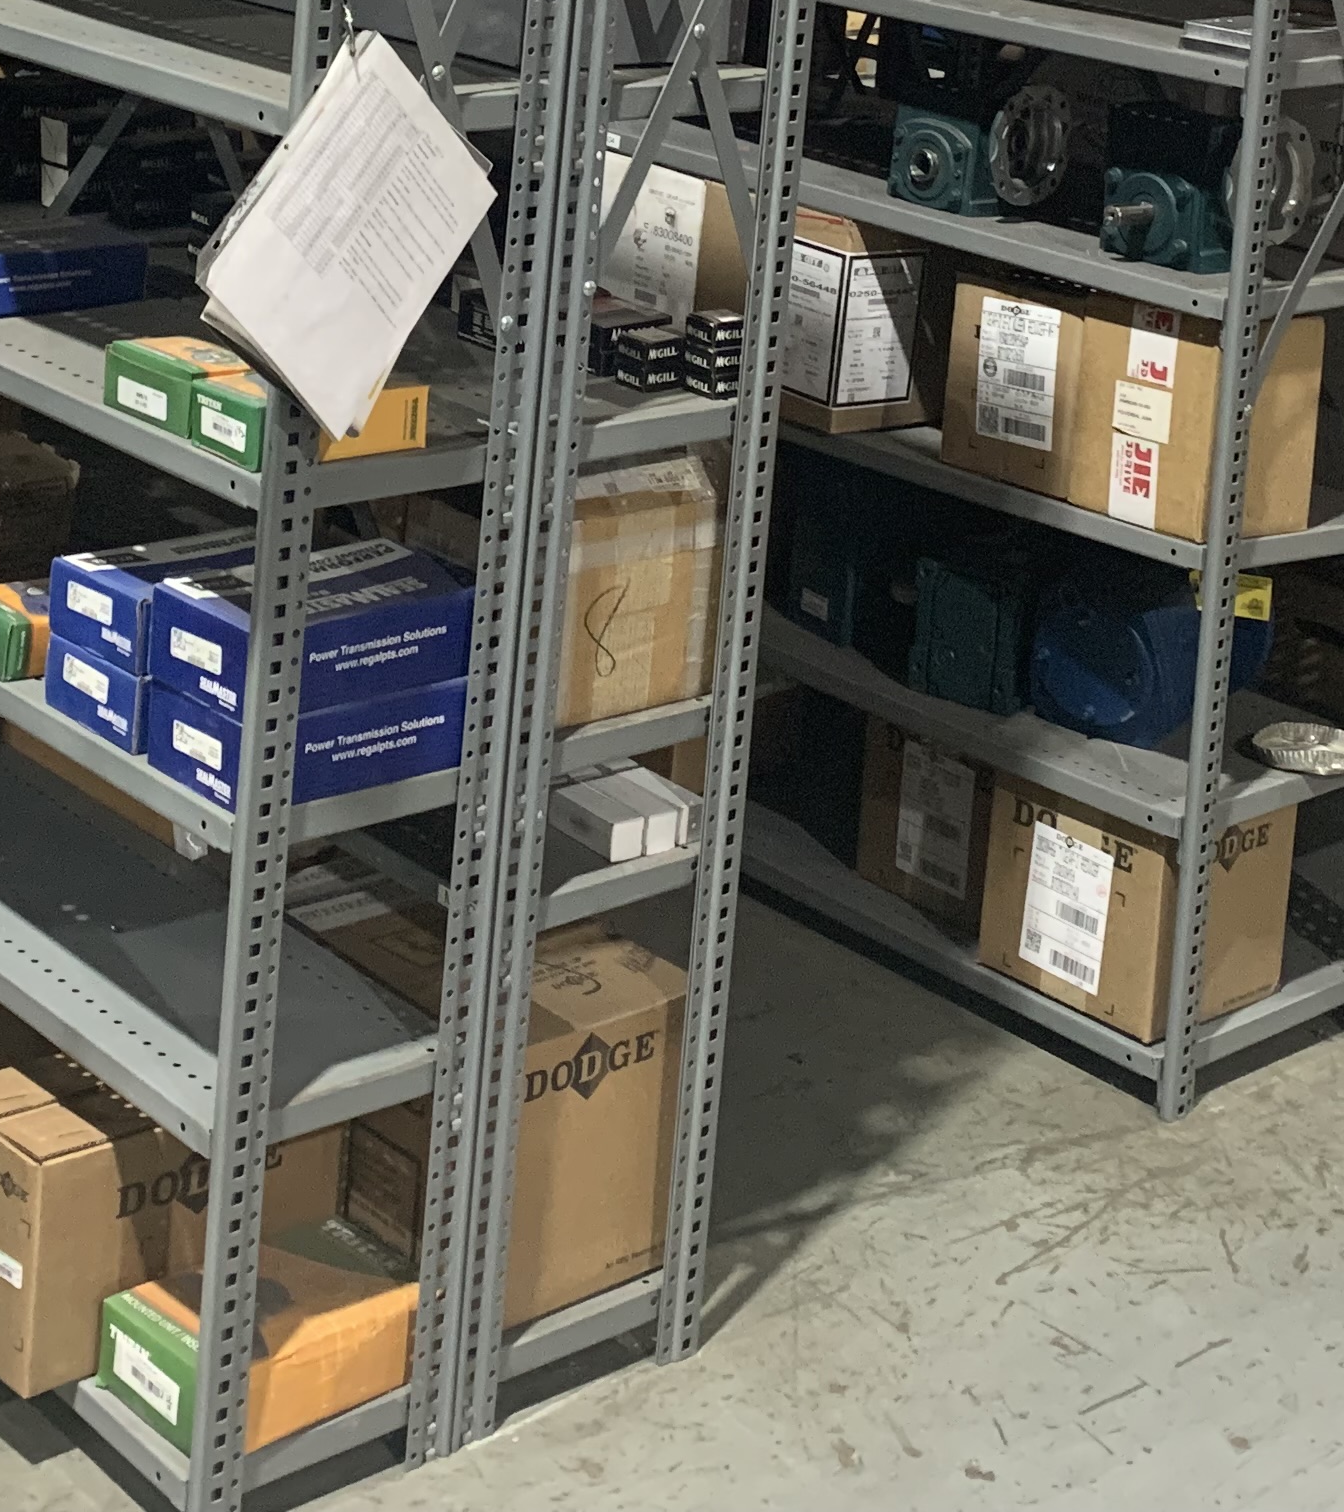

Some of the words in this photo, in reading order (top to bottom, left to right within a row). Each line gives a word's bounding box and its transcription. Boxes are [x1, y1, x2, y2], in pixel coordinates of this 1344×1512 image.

[309, 647, 339, 664] Power
[340, 635, 402, 656] Transmission
[403, 624, 447, 643] Solutions
[335, 645, 419, 672] www.regalpts.com
[304, 737, 335, 754] Power
[337, 724, 399, 747] Transmission
[400, 714, 446, 732] Solutions
[331, 734, 417, 762] www.regalpts.com
[195, 767, 232, 800] SEALMASTER
[524, 1030, 659, 1104] DODGE
[121, 1292, 158, 1325] MOUNTED
